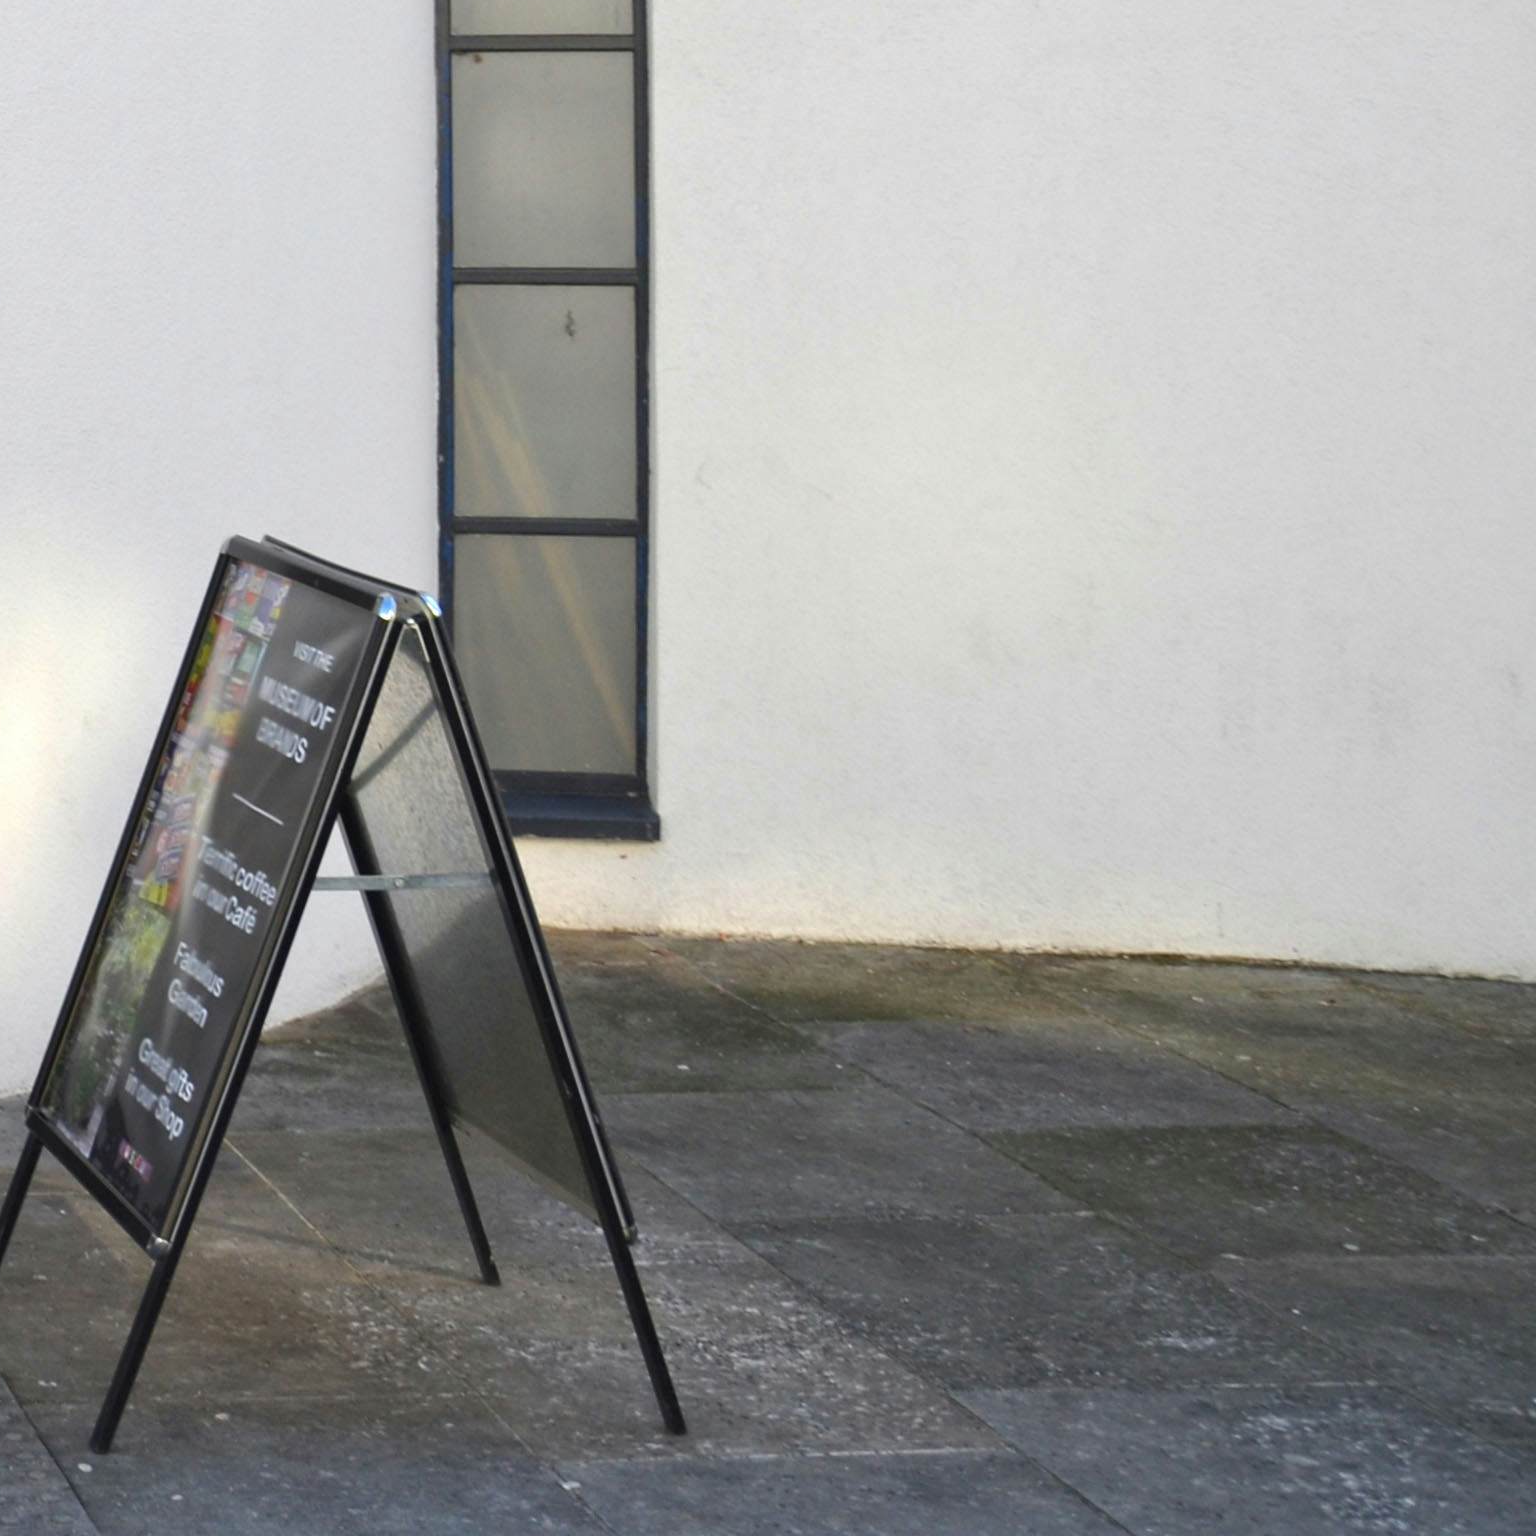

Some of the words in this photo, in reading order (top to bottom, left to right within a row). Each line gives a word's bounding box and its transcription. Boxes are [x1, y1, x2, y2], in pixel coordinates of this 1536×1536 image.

[313, 648, 336, 674] THE
[258, 675, 318, 723] MUSEUM
[310, 702, 336, 731] OF
[256, 716, 308, 764] BRANDS
[198, 834, 239, 882] Terrific
[234, 867, 277, 906] coffee
[192, 874, 209, 901] in
[206, 887, 229, 915] our
[224, 895, 258, 935] Café
[168, 977, 208, 1028] Garden
[138, 1037, 173, 1083] Great
[166, 1067, 195, 1103] gifts
[124, 1066, 139, 1097] in
[135, 1082, 158, 1112] our
[154, 1094, 185, 1141] Shop
